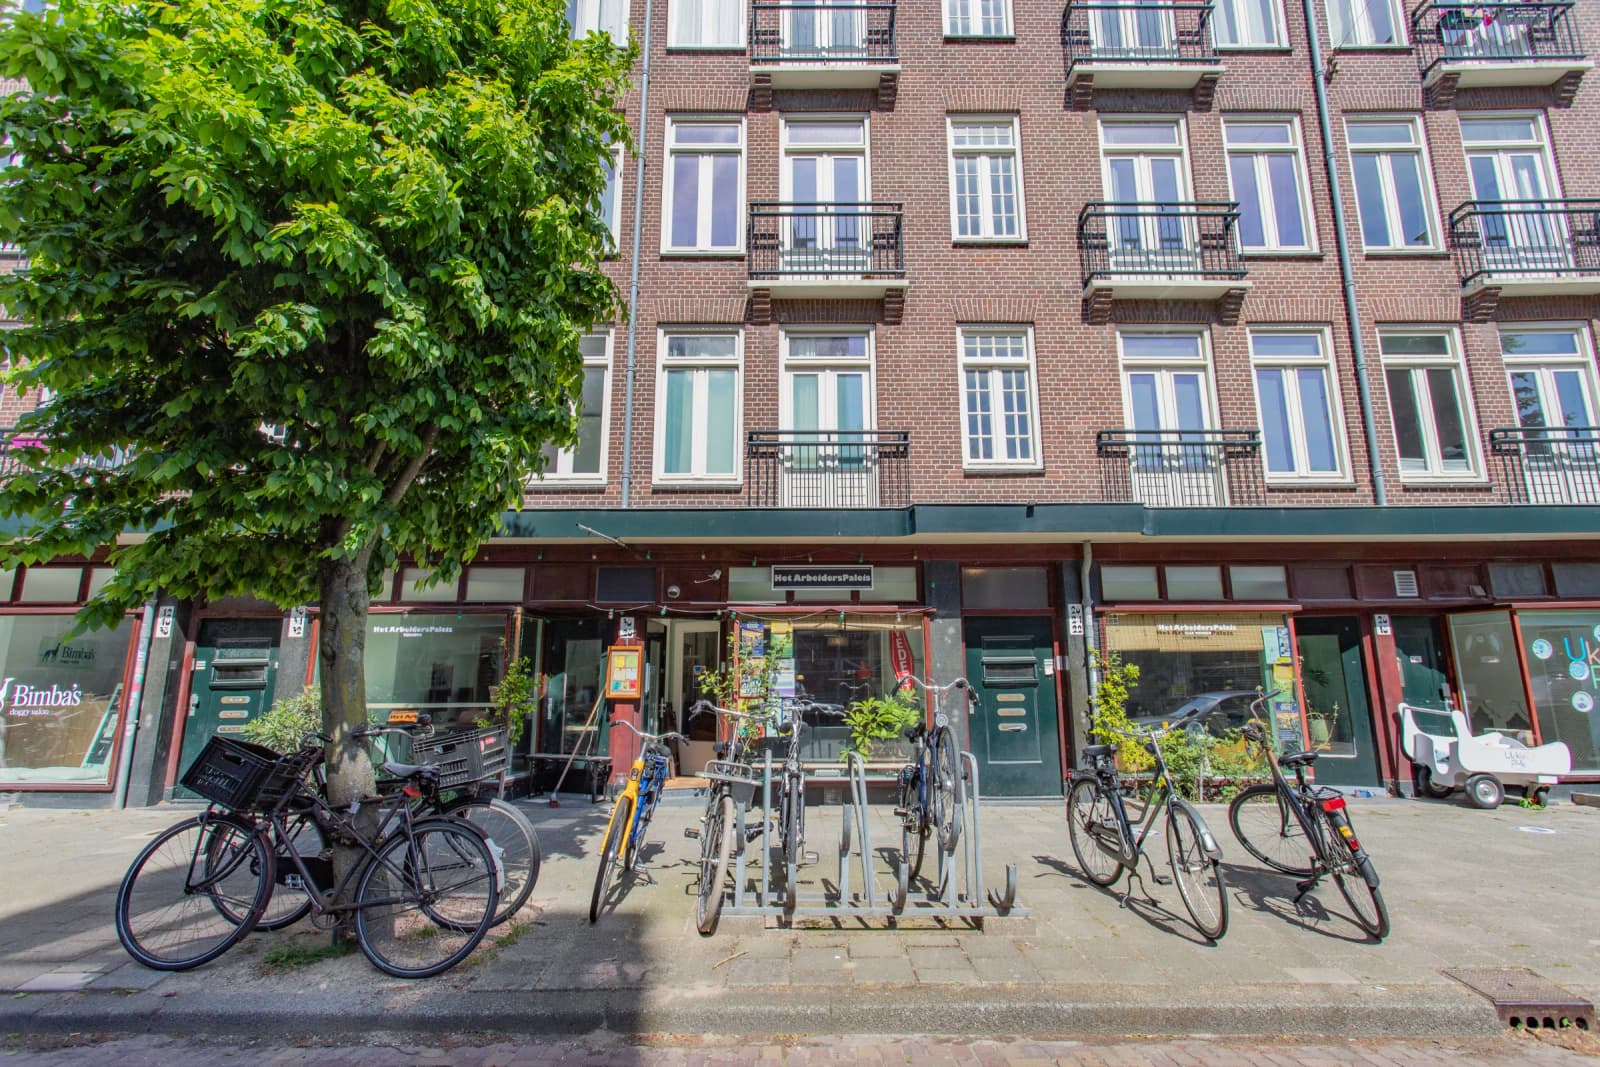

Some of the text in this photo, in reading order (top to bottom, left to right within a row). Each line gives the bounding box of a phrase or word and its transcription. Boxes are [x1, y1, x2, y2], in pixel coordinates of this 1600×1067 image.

[774, 574, 871, 582] Het ArbeidersPaleis
[61, 646, 96, 659] Bimba's
[11, 684, 82, 706] Bimba's
